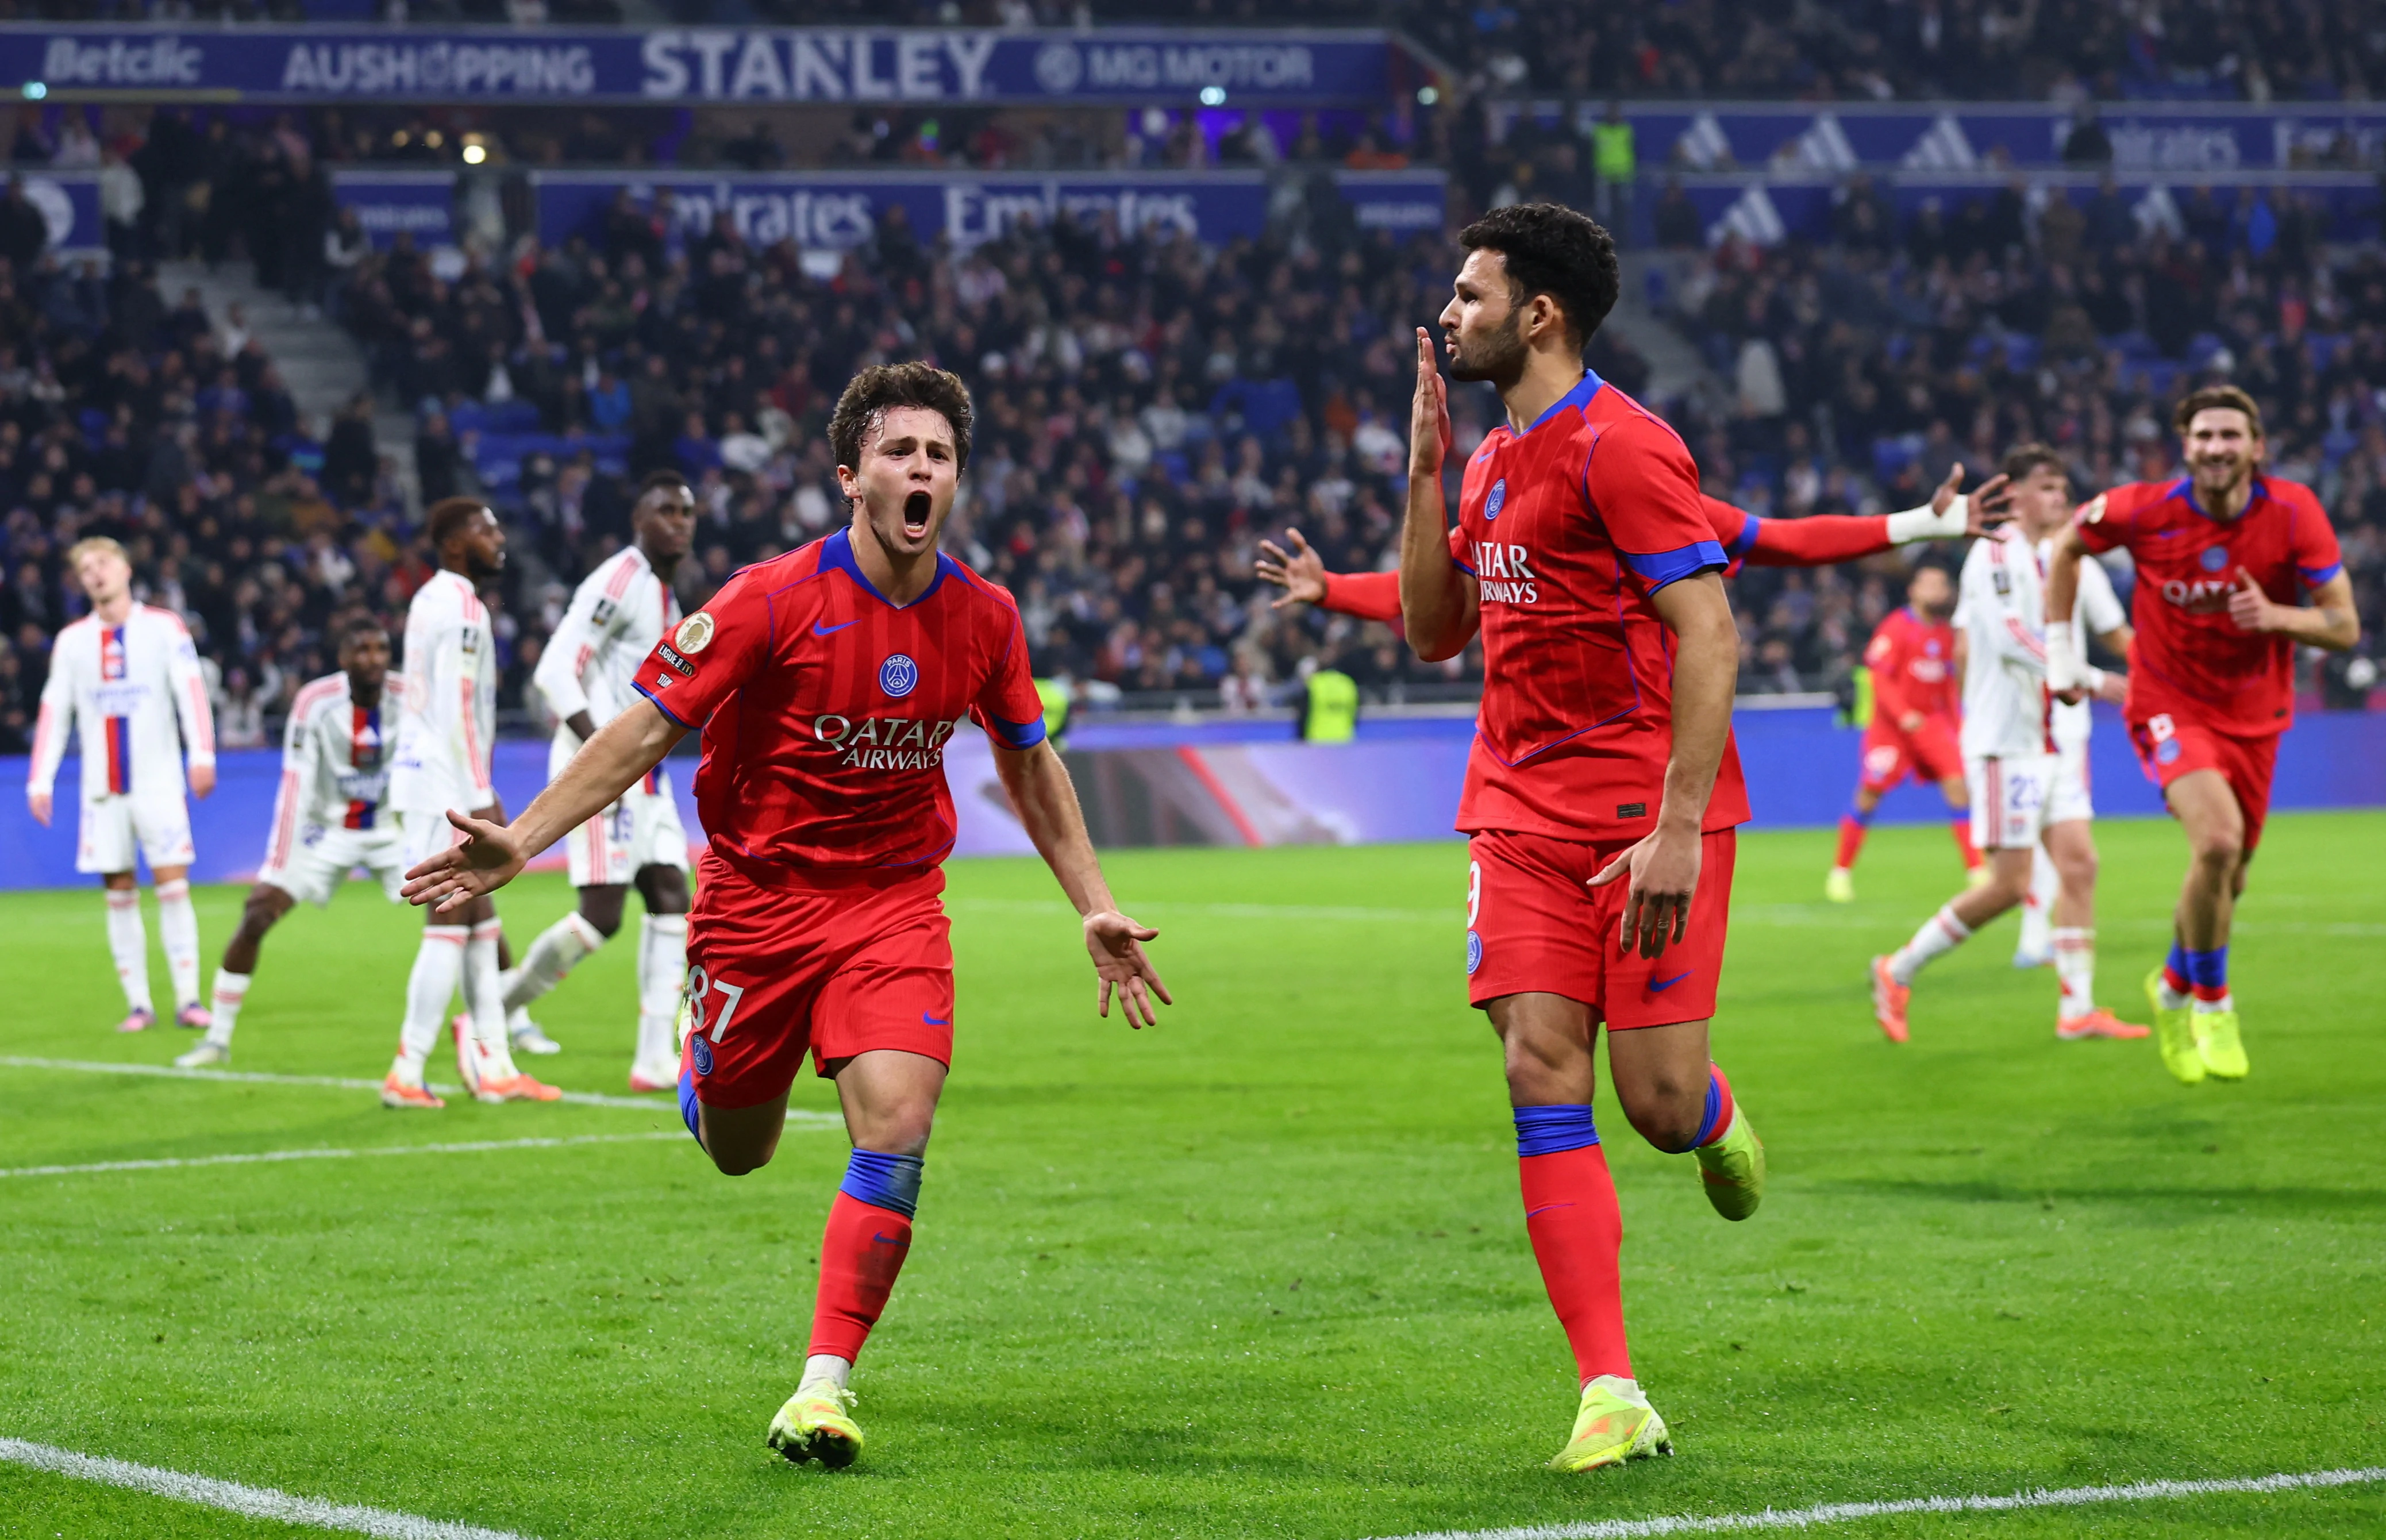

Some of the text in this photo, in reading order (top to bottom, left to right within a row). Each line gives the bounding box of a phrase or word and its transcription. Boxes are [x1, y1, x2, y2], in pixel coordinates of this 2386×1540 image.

[43, 37, 203, 83] Betclic
[640, 32, 994, 99] STANLEY
[1164, 46, 1314, 88] MOTOR
[624, 178, 873, 242] mirates
[1469, 539, 1535, 579] ATAR
[1479, 580, 1538, 603] IRWAYS
[2162, 579, 2237, 608] QAT
[657, 644, 678, 665] LIGUE
[886, 657, 911, 668] PARIS
[814, 715, 953, 752] QATAR
[841, 748, 942, 770] AIRWAYS
[688, 964, 744, 1044] 87
